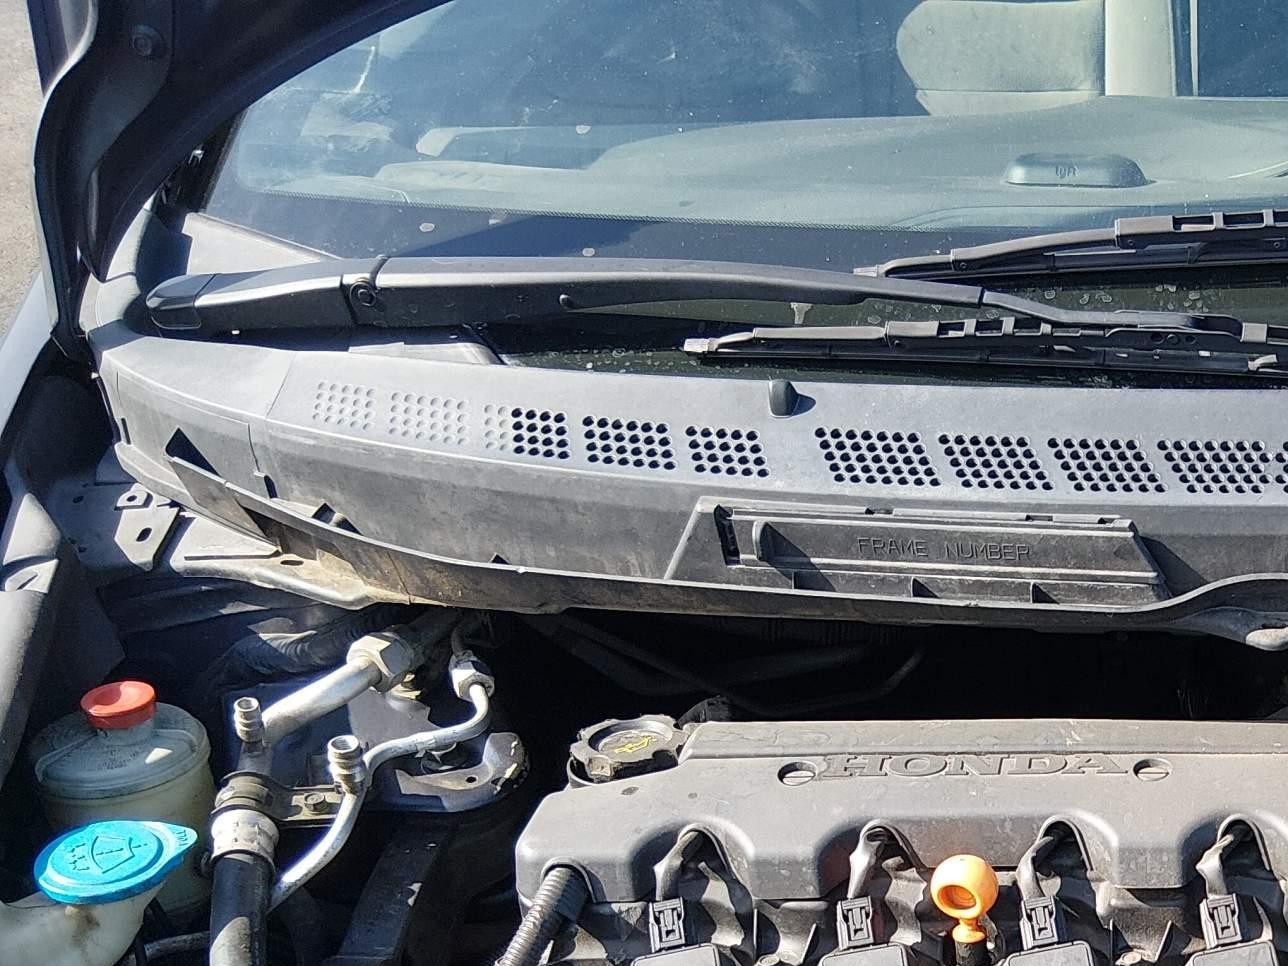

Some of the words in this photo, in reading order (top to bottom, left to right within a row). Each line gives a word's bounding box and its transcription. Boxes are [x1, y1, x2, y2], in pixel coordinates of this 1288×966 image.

[1055, 166, 1077, 178] lyft
[856, 538, 929, 557] FRAME
[944, 543, 1031, 561] NUMBER
[821, 754, 1130, 777] HONDA
